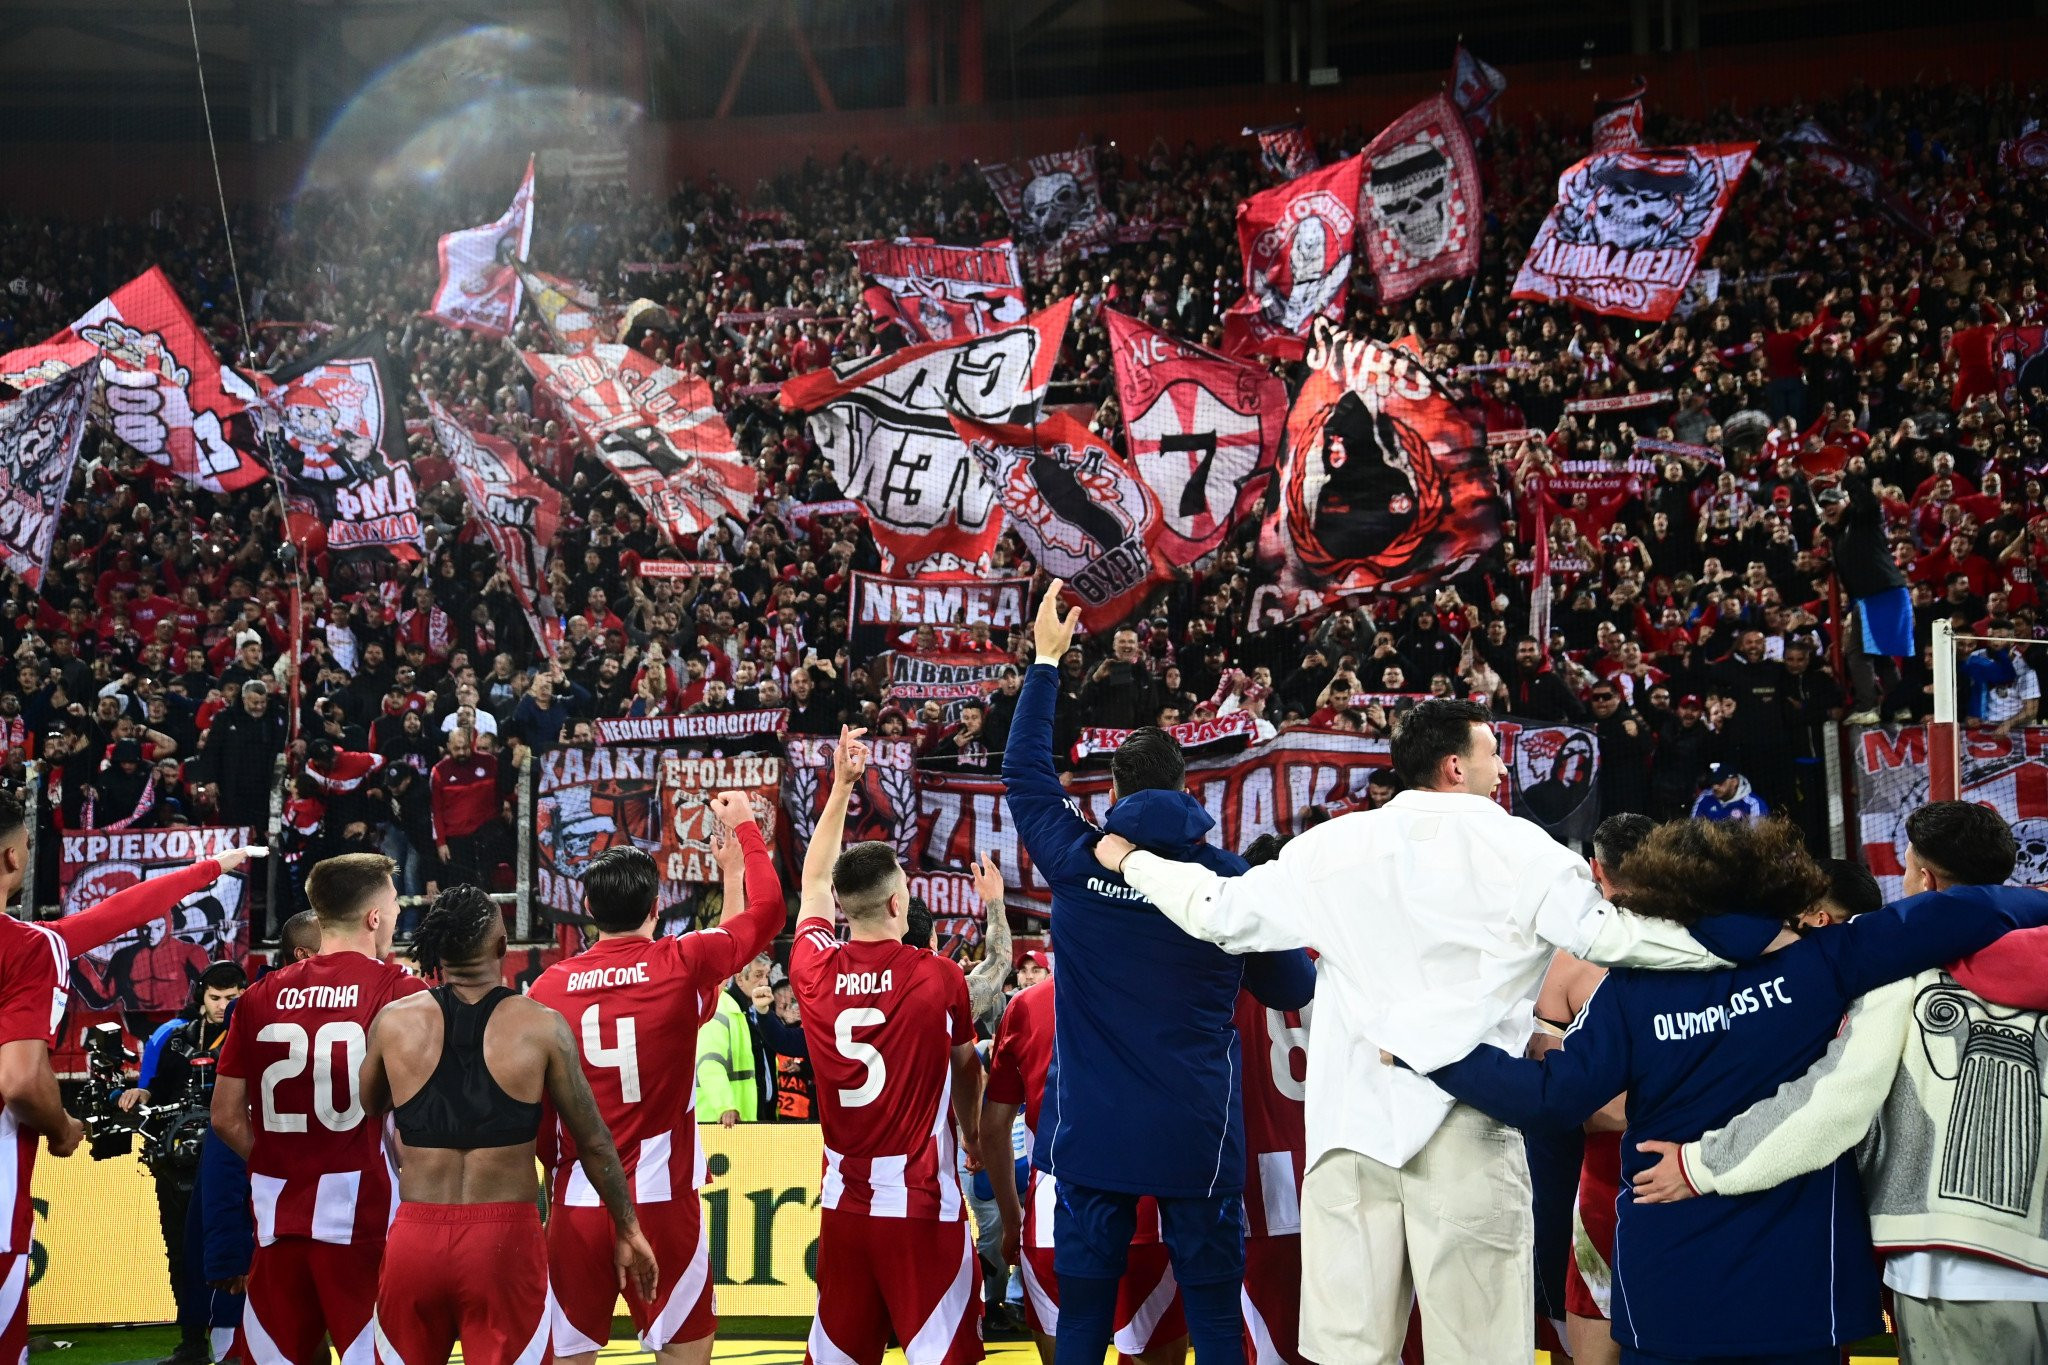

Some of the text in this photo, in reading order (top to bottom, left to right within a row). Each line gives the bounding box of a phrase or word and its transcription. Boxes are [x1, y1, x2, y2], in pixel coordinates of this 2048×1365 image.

[1160, 428, 1217, 518] 7
[861, 582, 1024, 628] NEMEA
[600, 718, 671, 742] ΝΕΟΧΩΡΙ
[666, 757, 779, 788] ETOLIKO
[567, 961, 650, 991] BIANCONE
[834, 969, 893, 995] PIROLA
[1758, 976, 1793, 1008] FC
[275, 984, 359, 1010] COSTINHA
[581, 1003, 642, 1104] 4
[834, 1007, 887, 1108] 5
[255, 1020, 367, 1133] 20
